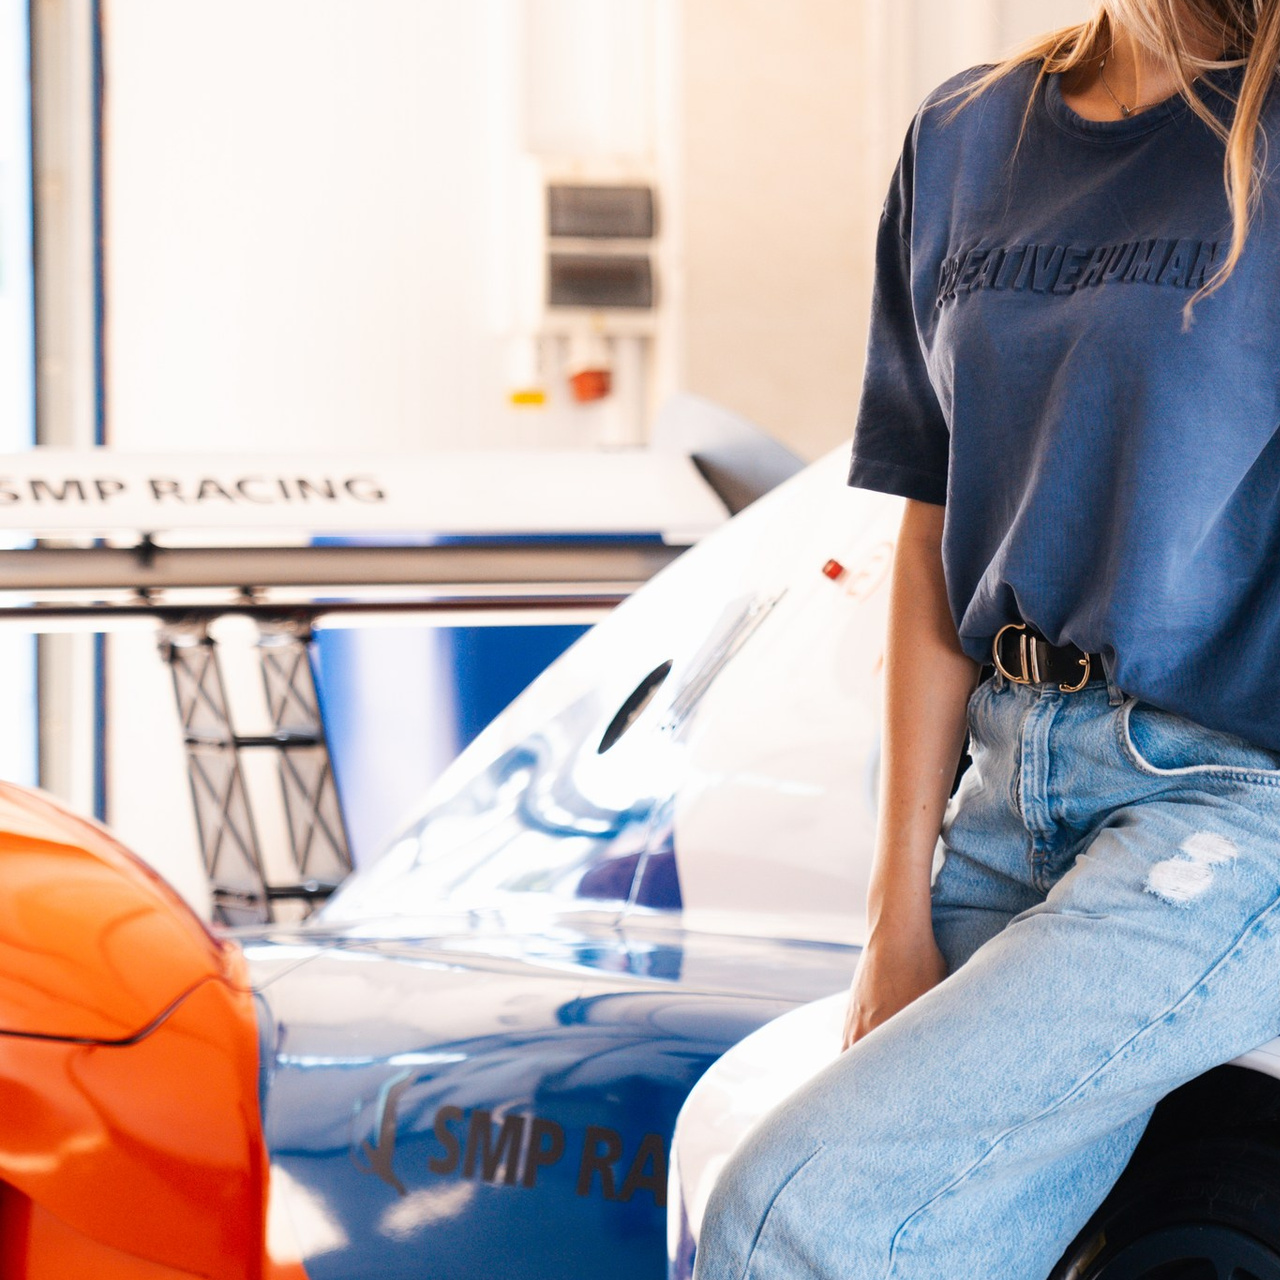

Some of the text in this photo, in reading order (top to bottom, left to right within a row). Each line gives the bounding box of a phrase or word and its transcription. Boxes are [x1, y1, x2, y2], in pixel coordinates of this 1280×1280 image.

[0, 478, 386, 505] SMP RACING
[428, 1105, 668, 1208] SMP RA
